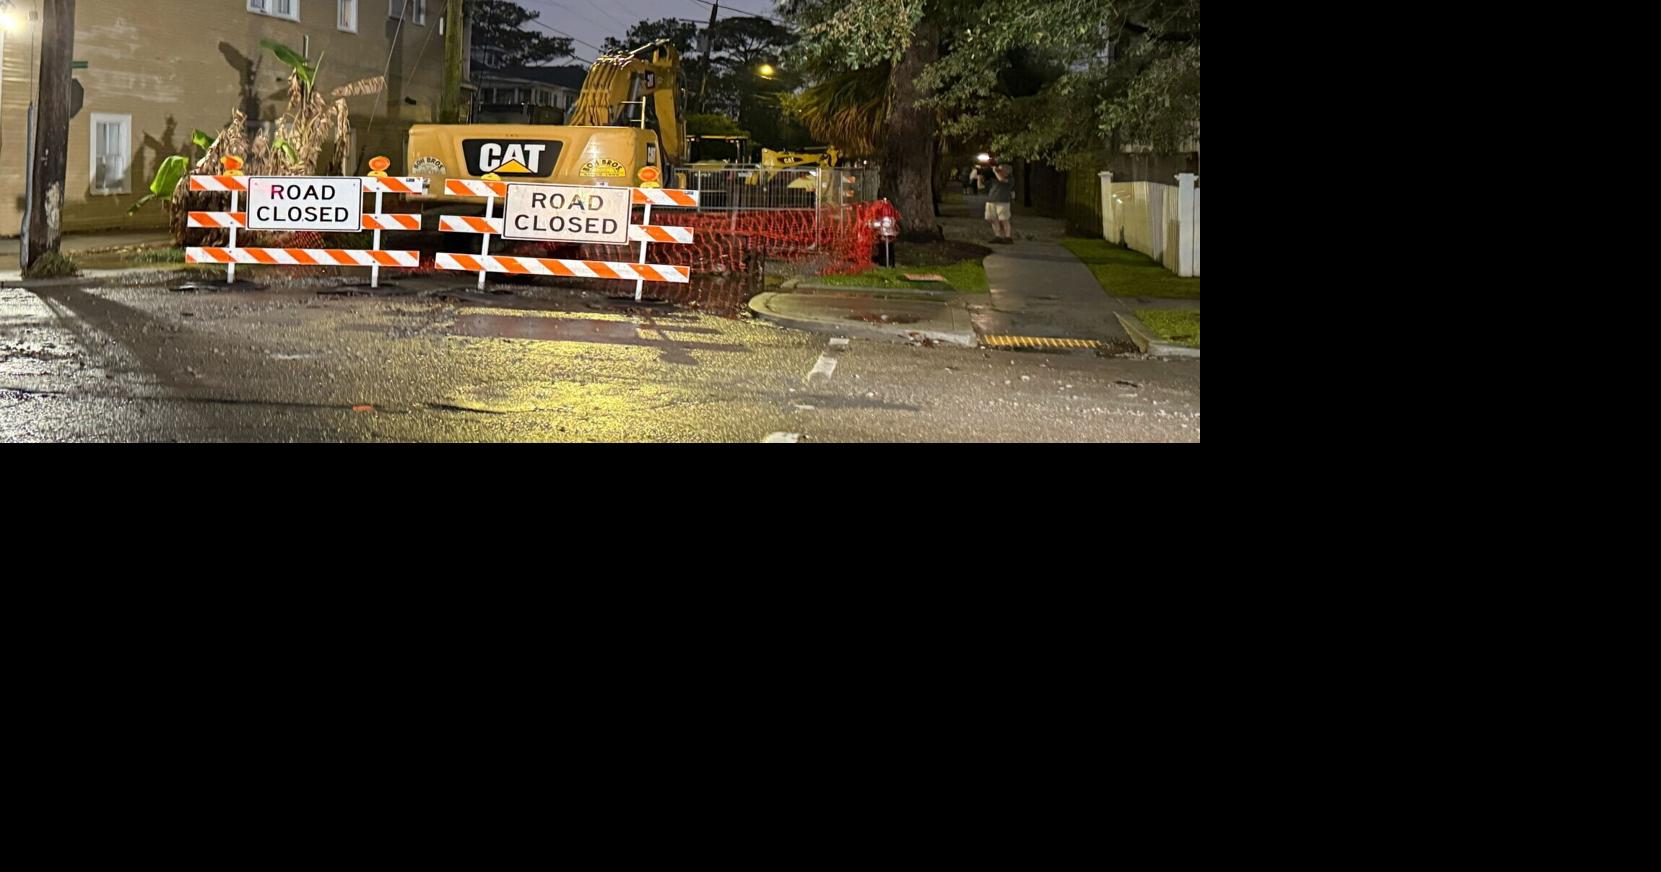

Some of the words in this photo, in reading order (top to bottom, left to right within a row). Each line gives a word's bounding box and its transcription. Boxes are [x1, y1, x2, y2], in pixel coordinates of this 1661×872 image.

[479, 142, 546, 173] CAT
[270, 184, 336, 201] ROAD
[531, 192, 604, 211] ROAD
[256, 206, 349, 223] CLOSED
[514, 214, 619, 235] CLOSED
